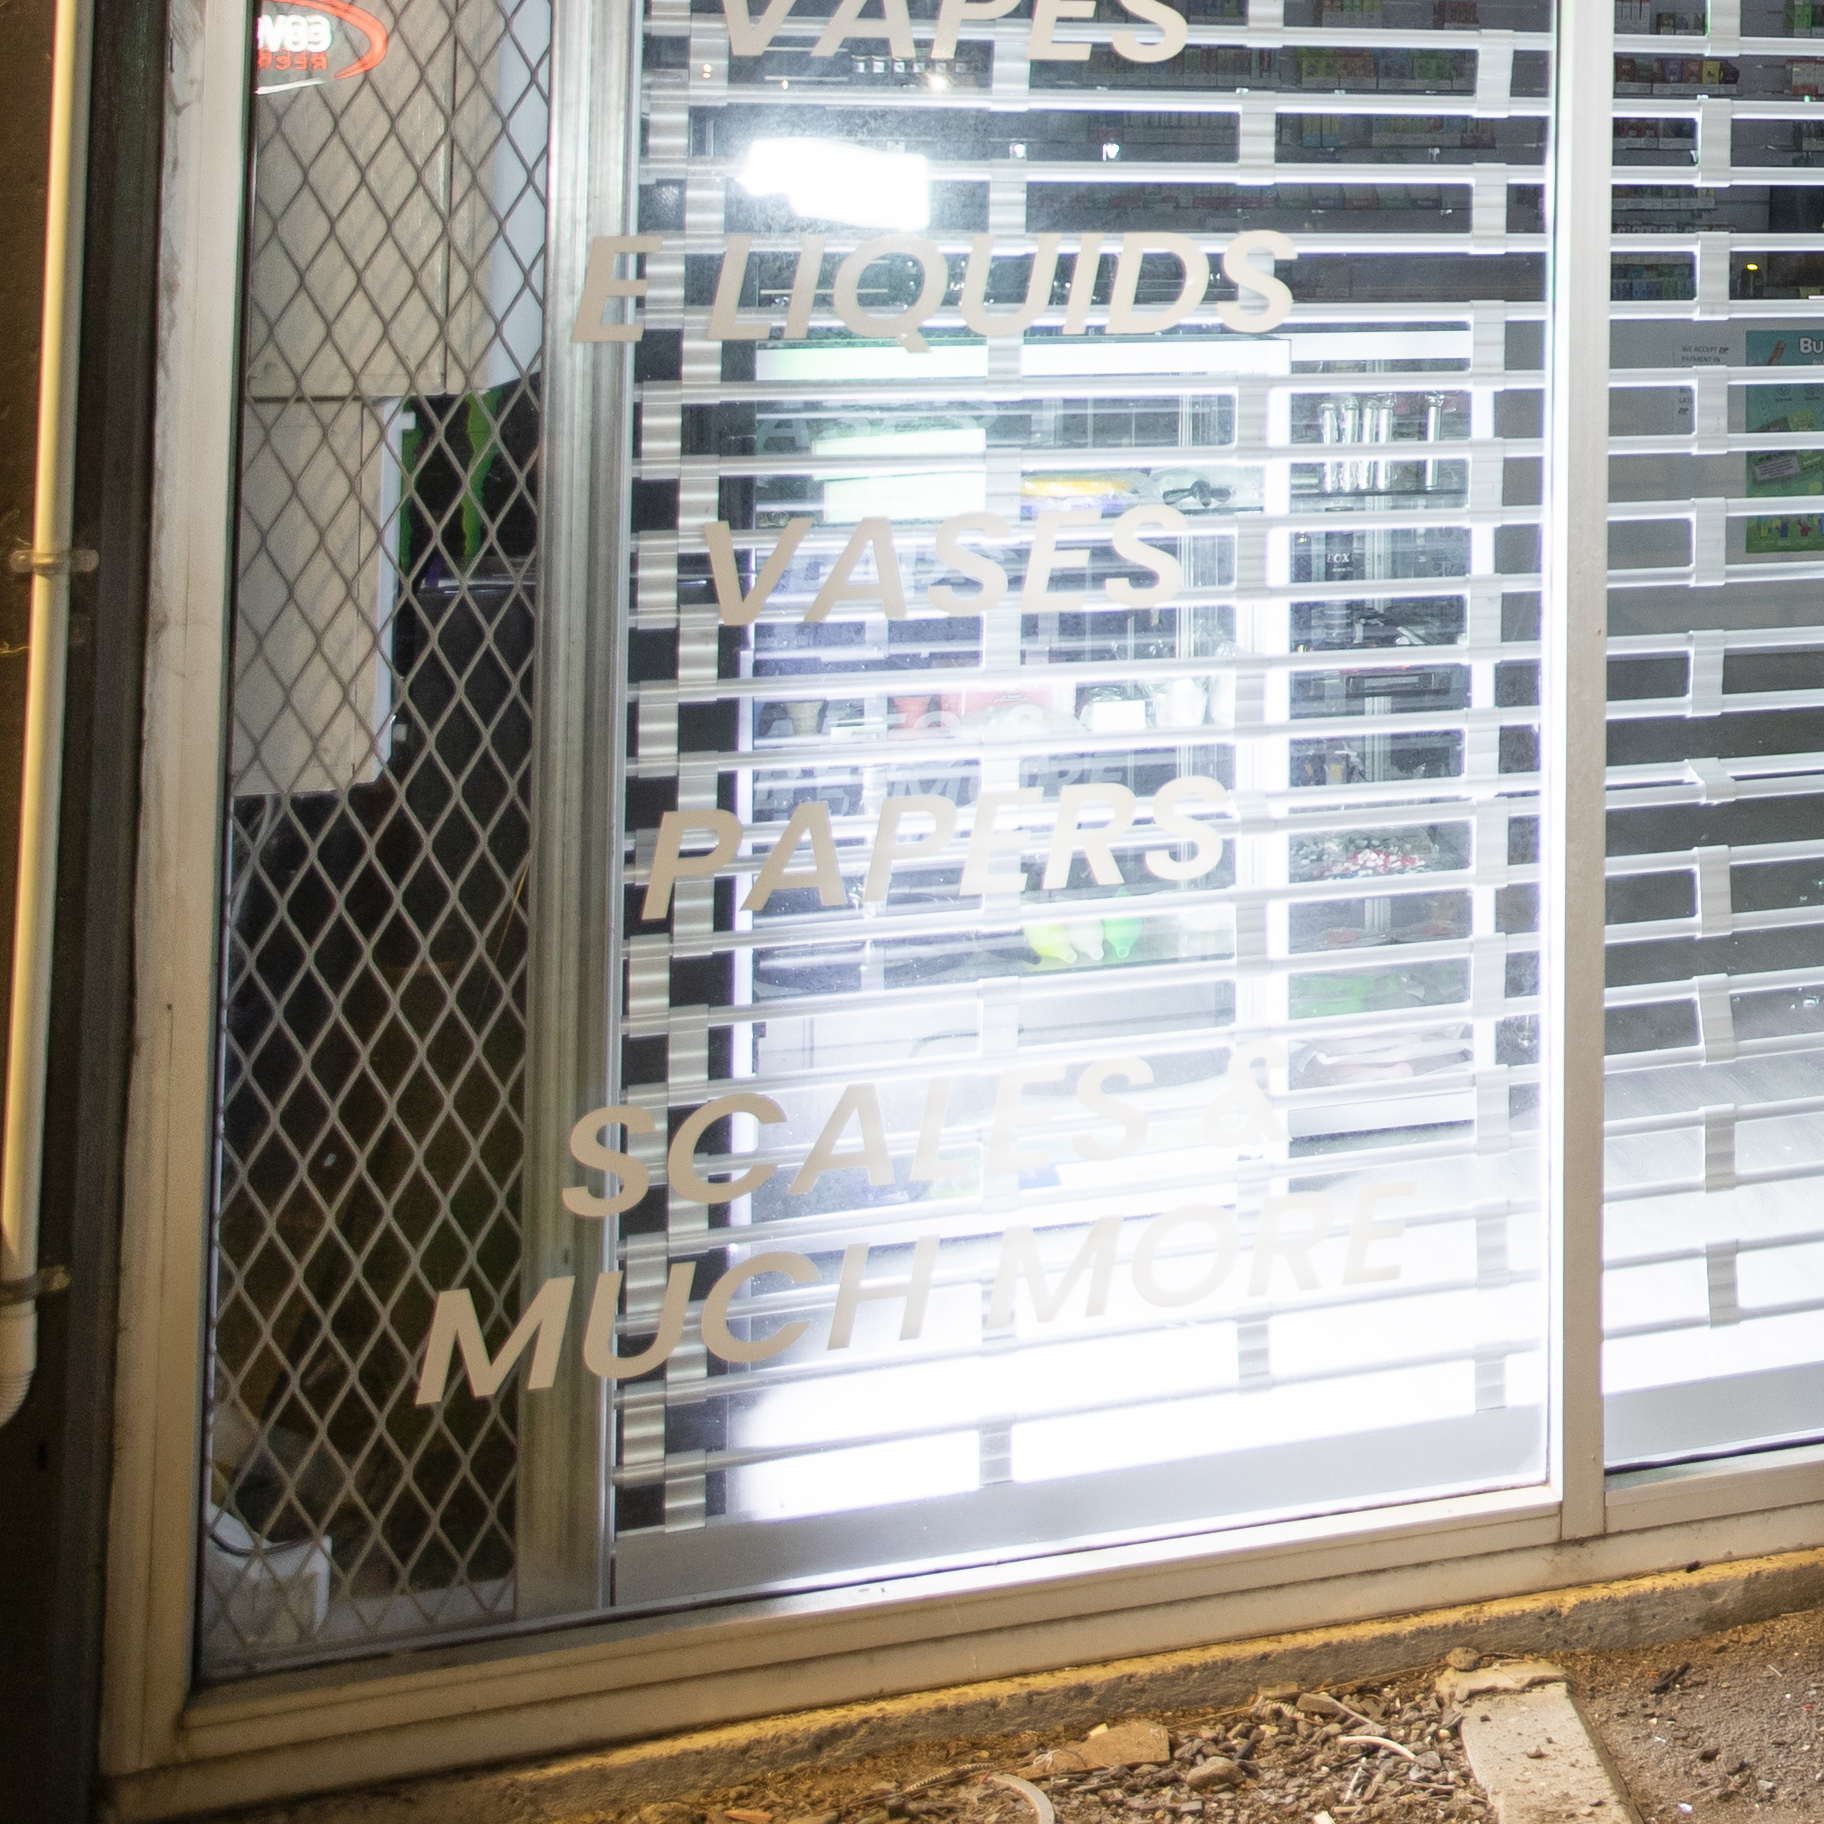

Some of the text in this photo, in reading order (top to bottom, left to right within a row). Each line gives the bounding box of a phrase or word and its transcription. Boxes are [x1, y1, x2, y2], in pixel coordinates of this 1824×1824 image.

[572, 229, 1298, 353] E LIQUIDS
[702, 504, 1191, 627] VASES
[640, 775, 1232, 921] PAPERS
[562, 1037, 1294, 1219] SCALES &
[414, 1182, 1417, 1407] MUCH MORE
